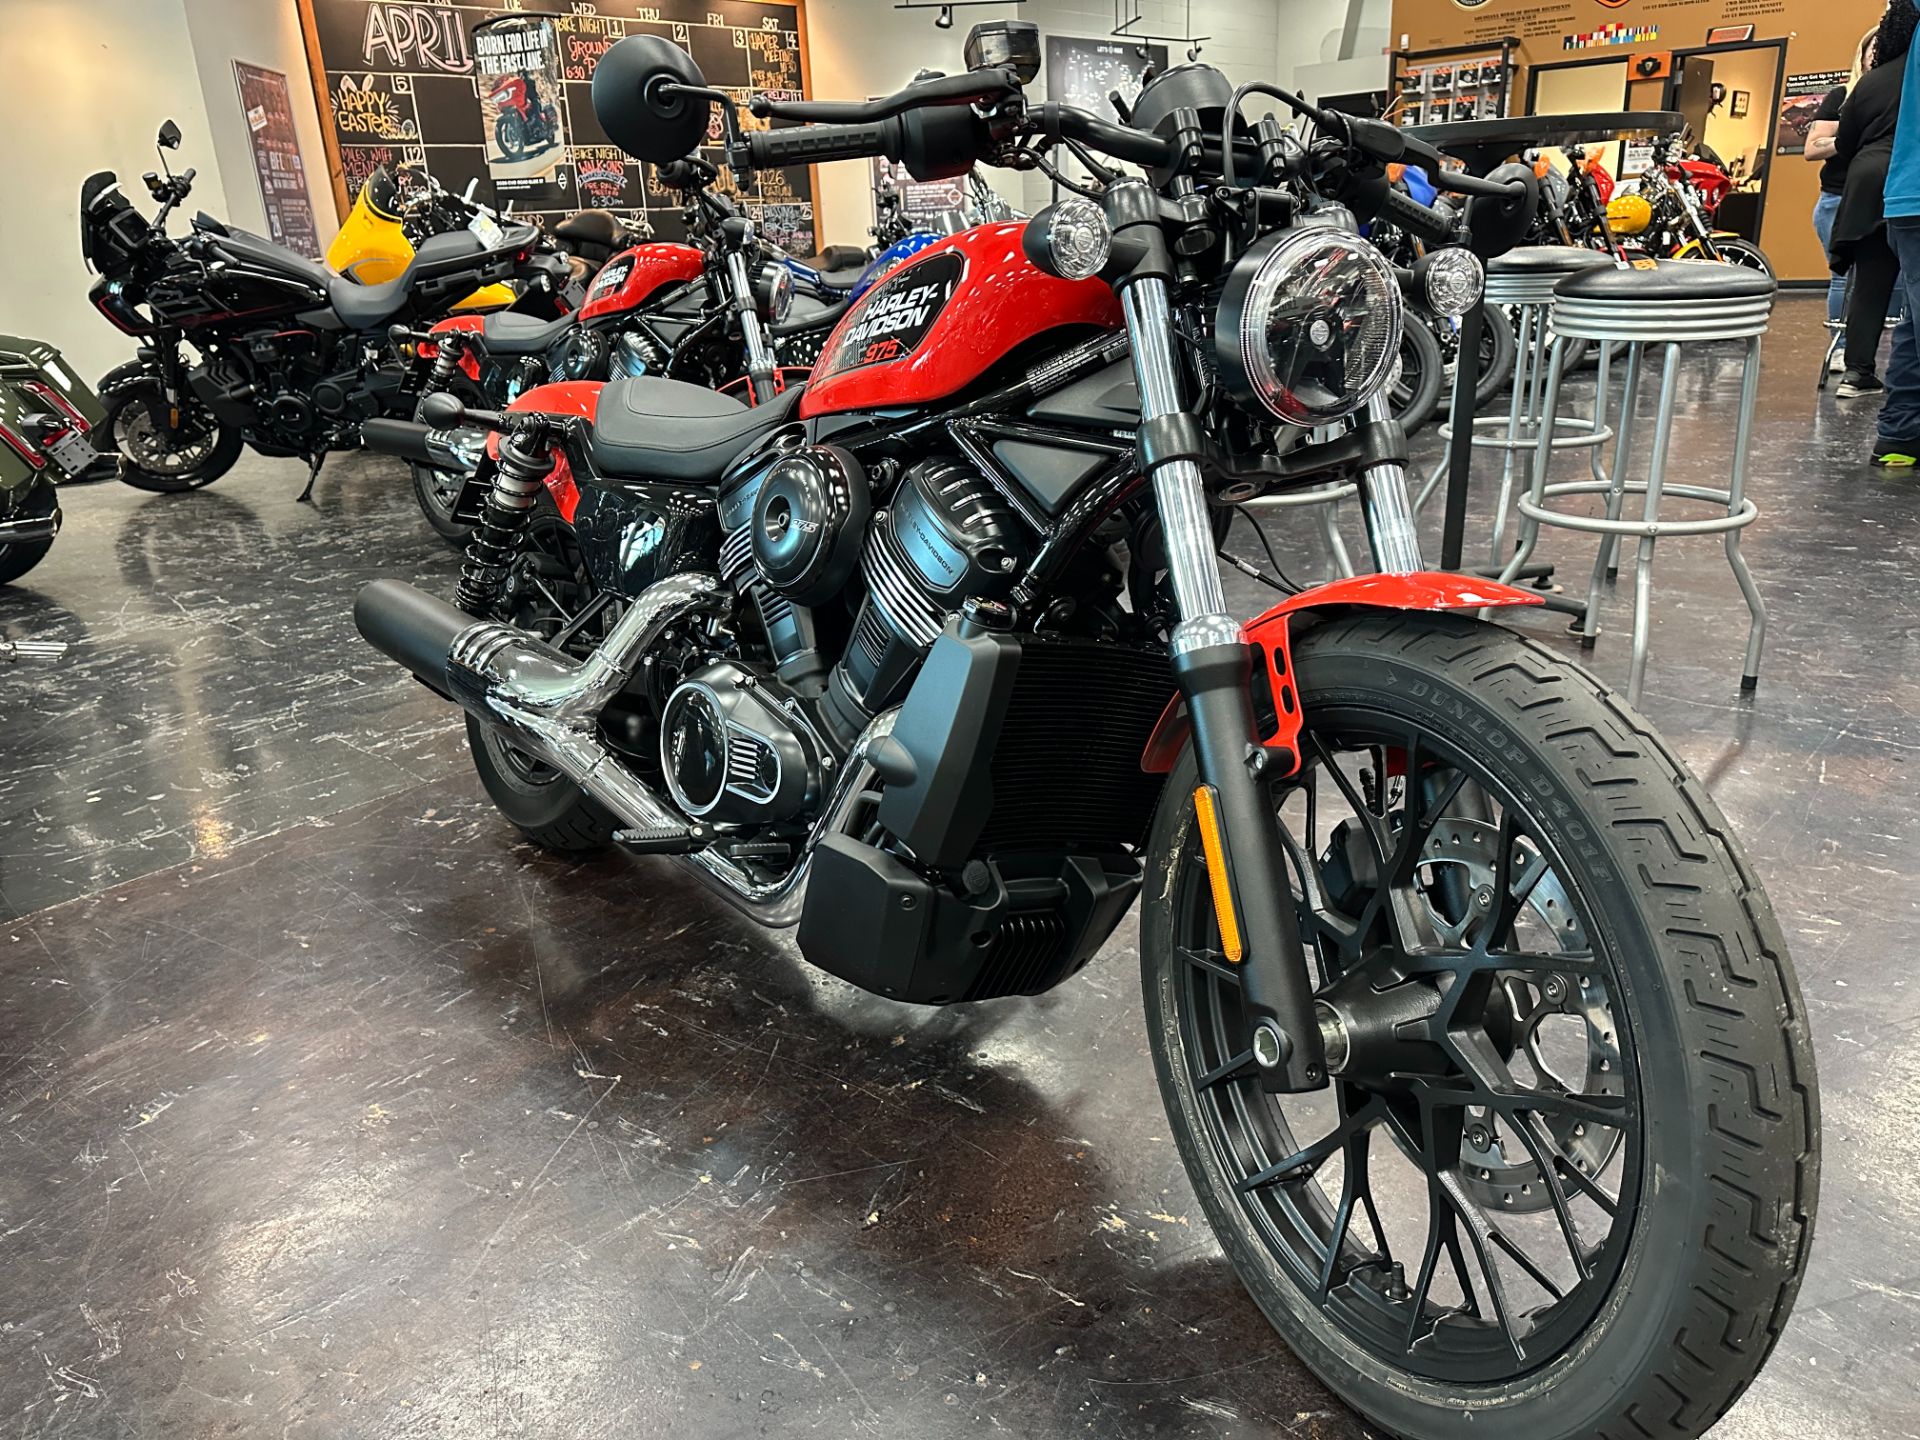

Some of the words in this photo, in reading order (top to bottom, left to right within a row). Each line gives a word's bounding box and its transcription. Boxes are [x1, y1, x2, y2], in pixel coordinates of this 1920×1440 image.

[571, 2, 596, 15] WED
[636, 7, 660, 20] THU
[580, 17, 606, 35] NIGHT
[707, 13, 724, 26] FRI
[762, 17, 779, 31] SAT
[611, 21, 622, 36] 1
[676, 24, 687, 40] 2
[363, 3, 475, 74] APRIL
[476, 34, 506, 55] BORN
[504, 32, 524, 53] FOR
[522, 30, 541, 51] LIFE
[538, 28, 549, 48] IN
[735, 30, 745, 45] 3
[788, 33, 797, 49] 4
[479, 55, 500, 75] THE
[396, 76, 408, 91] 5
[338, 88, 386, 113] HAPPY
[740, 89, 750, 101] 10
[407, 147, 424, 162] 12
[574, 148, 594, 160] BIKE
[595, 148, 622, 160] NIGHT
[753, 169, 785, 186] 2026
[862, 282, 940, 323] HARLEY-
[841, 304, 931, 348] DAVIDSON
[864, 338, 900, 363] 975
[1408, 678, 1529, 765] DUNLOP
